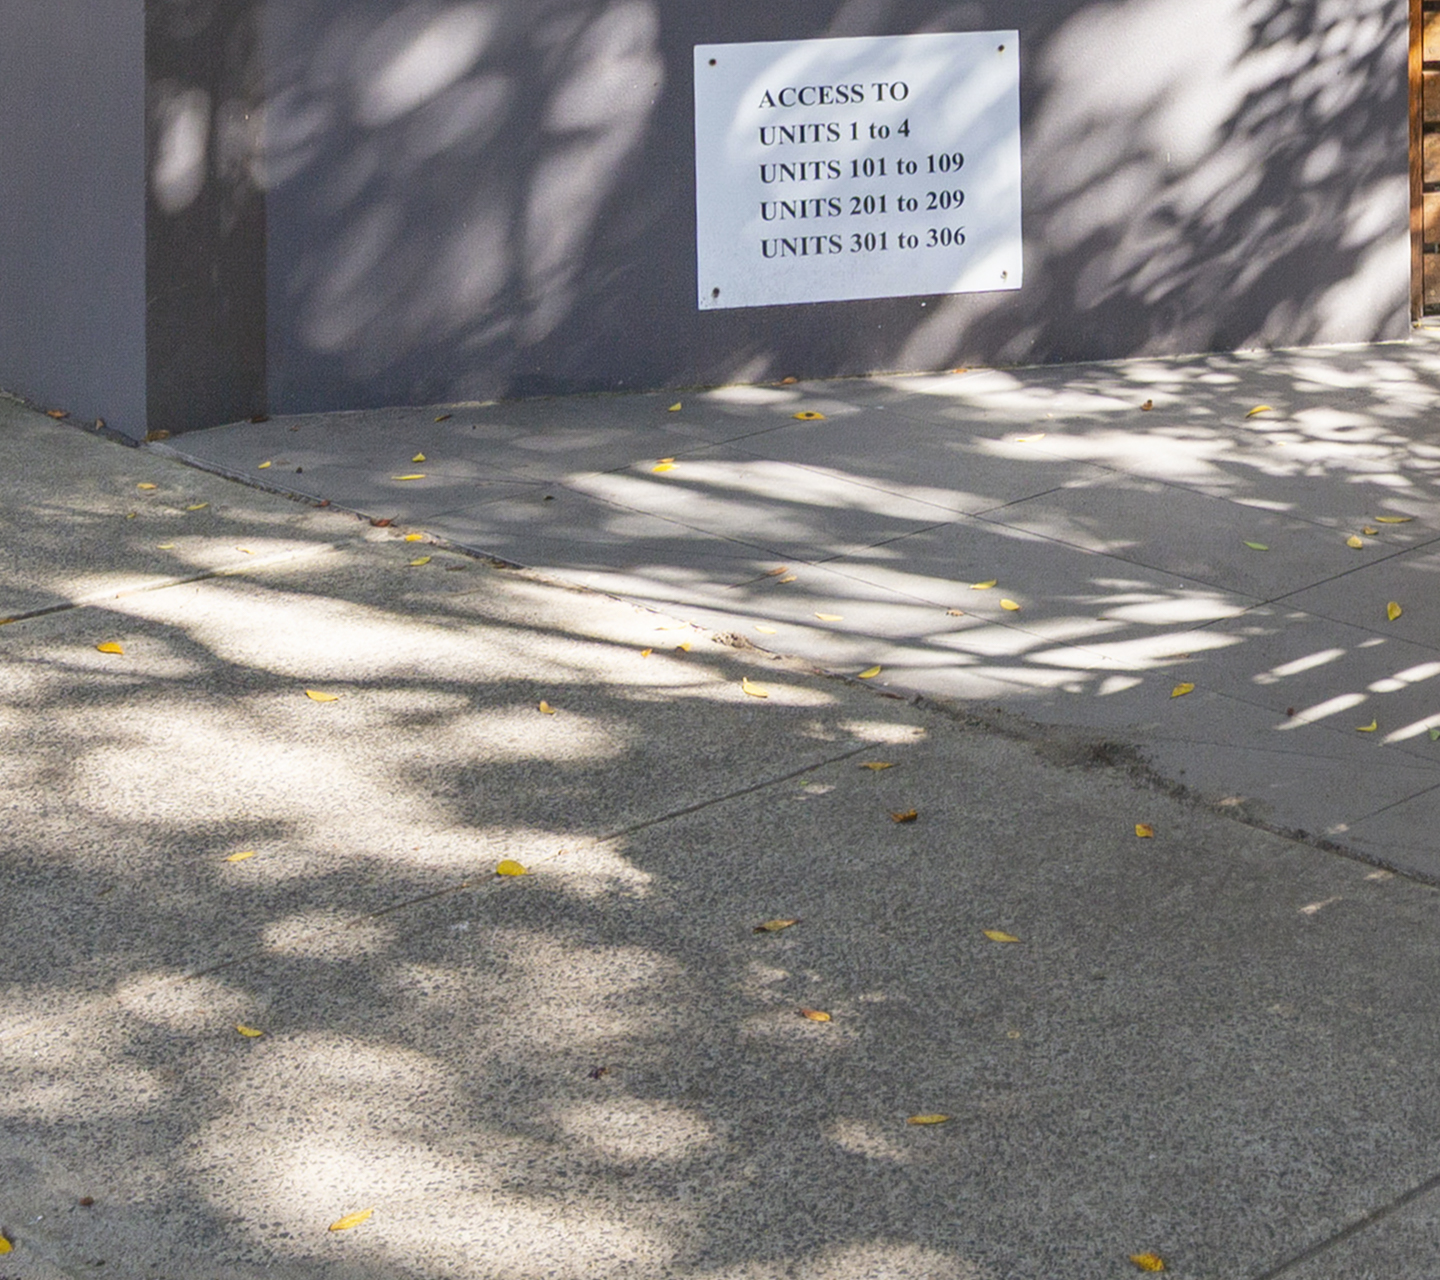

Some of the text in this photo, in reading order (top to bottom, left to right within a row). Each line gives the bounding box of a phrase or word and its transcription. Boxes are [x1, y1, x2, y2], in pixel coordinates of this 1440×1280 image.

[758, 81, 909, 109] ACCESS TO
[759, 119, 910, 146] UNITS 1 to 4
[760, 152, 964, 184] UNITS 101 to 109
[760, 189, 965, 221] UNITS 201 to 209
[761, 227, 966, 258] UNITS 301 to 306
